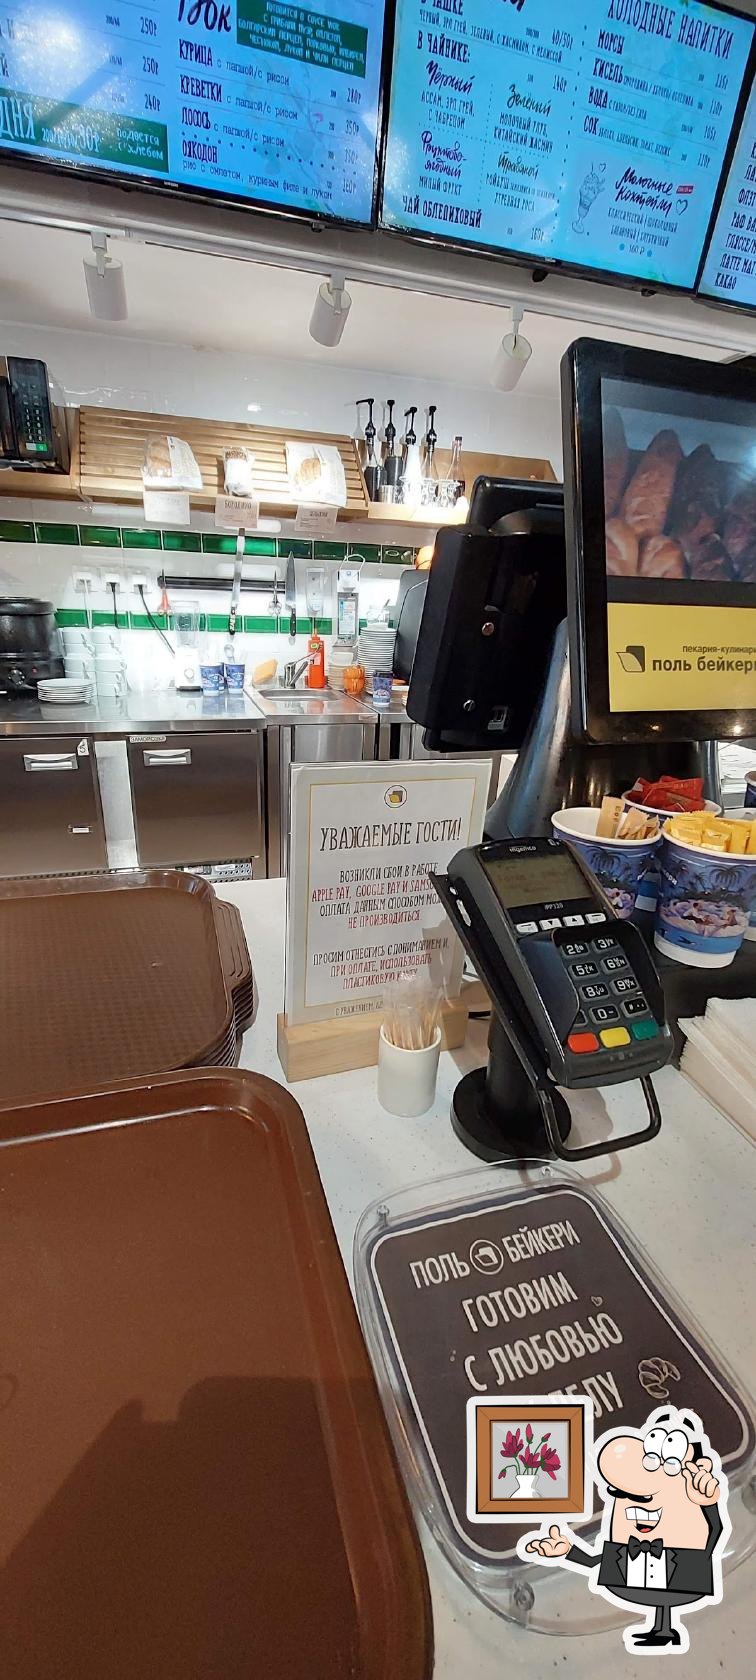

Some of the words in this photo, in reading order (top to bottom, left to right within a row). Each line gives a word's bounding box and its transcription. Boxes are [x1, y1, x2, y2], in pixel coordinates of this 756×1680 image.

[597, 28, 625, 55] МОРСЫ
[607, 0, 676, 39] ХОЛОДНЫЕ
[678, 13, 734, 60] НАПИТКИ
[179, 39, 213, 67] КУРИЦА
[417, 30, 423, 50] В
[427, 33, 471, 63] ЧАЙНИКЕ:
[592, 57, 624, 84] КИСЕЛЬ
[180, 74, 222, 103] КРЕВЕТКИ
[588, 85, 608, 109] ВОДА
[182, 106, 211, 130] ЛОСОСЬ
[583, 115, 599, 136] СОК
[182, 140, 217, 164] ОЯКОДОН
[402, 195, 420, 215] ЧАЙ
[422, 199, 482, 229] ОБЛЕПИХОВЫЙ
[731, 212, 745, 229] РАФ
[720, 253, 741, 272] ЛАТТЕ
[714, 272, 737, 290] КАКАО
[652, 659, 692, 671] поль
[320, 822, 412, 851] УВАЖАЕМЫЕ
[415, 817, 462, 844] ГОСТИ!
[340, 867, 381, 883] ВОЗНИКЛИ
[383, 865, 403, 879] СБОИ
[404, 865, 410, 877] В
[411, 862, 438, 876] РАБОТЕ
[312, 888, 333, 902] APPLE
[356, 882, 385, 898] GOOGLE
[387, 881, 401, 895] PAY
[402, 880, 408, 893] И
[320, 903, 351, 917] ОПЛАТА
[353, 898, 385, 914] ДАННЫМ
[387, 894, 425, 910] СПОСОБОМ
[348, 916, 358, 929] НЕ
[359, 910, 421, 928] ПРОИЗВОДИТЬСЯ
[313, 951, 344, 966] ПРОСИМ
[345, 945, 385, 961] ОТНЕСТИСЬ
[387, 944, 393, 955] С
[393, 938, 441, 954] ПОНИМАНИЕМ
[330, 965, 346, 978] ПРИ
[380, 953, 432, 971] ИСПОЛЬЗОВАТЬ
[342, 972, 395, 990] ПЛАСТИКОВУЮ
[409, 1252, 472, 1289] ПОЛЬ
[501, 1219, 581, 1263] БЕЙКЕРИ
[461, 1271, 579, 1333] ГОТОВИМ
[463, 1355, 489, 1392] С
[487, 1312, 624, 1386] ЛЮБОВЬЮ
